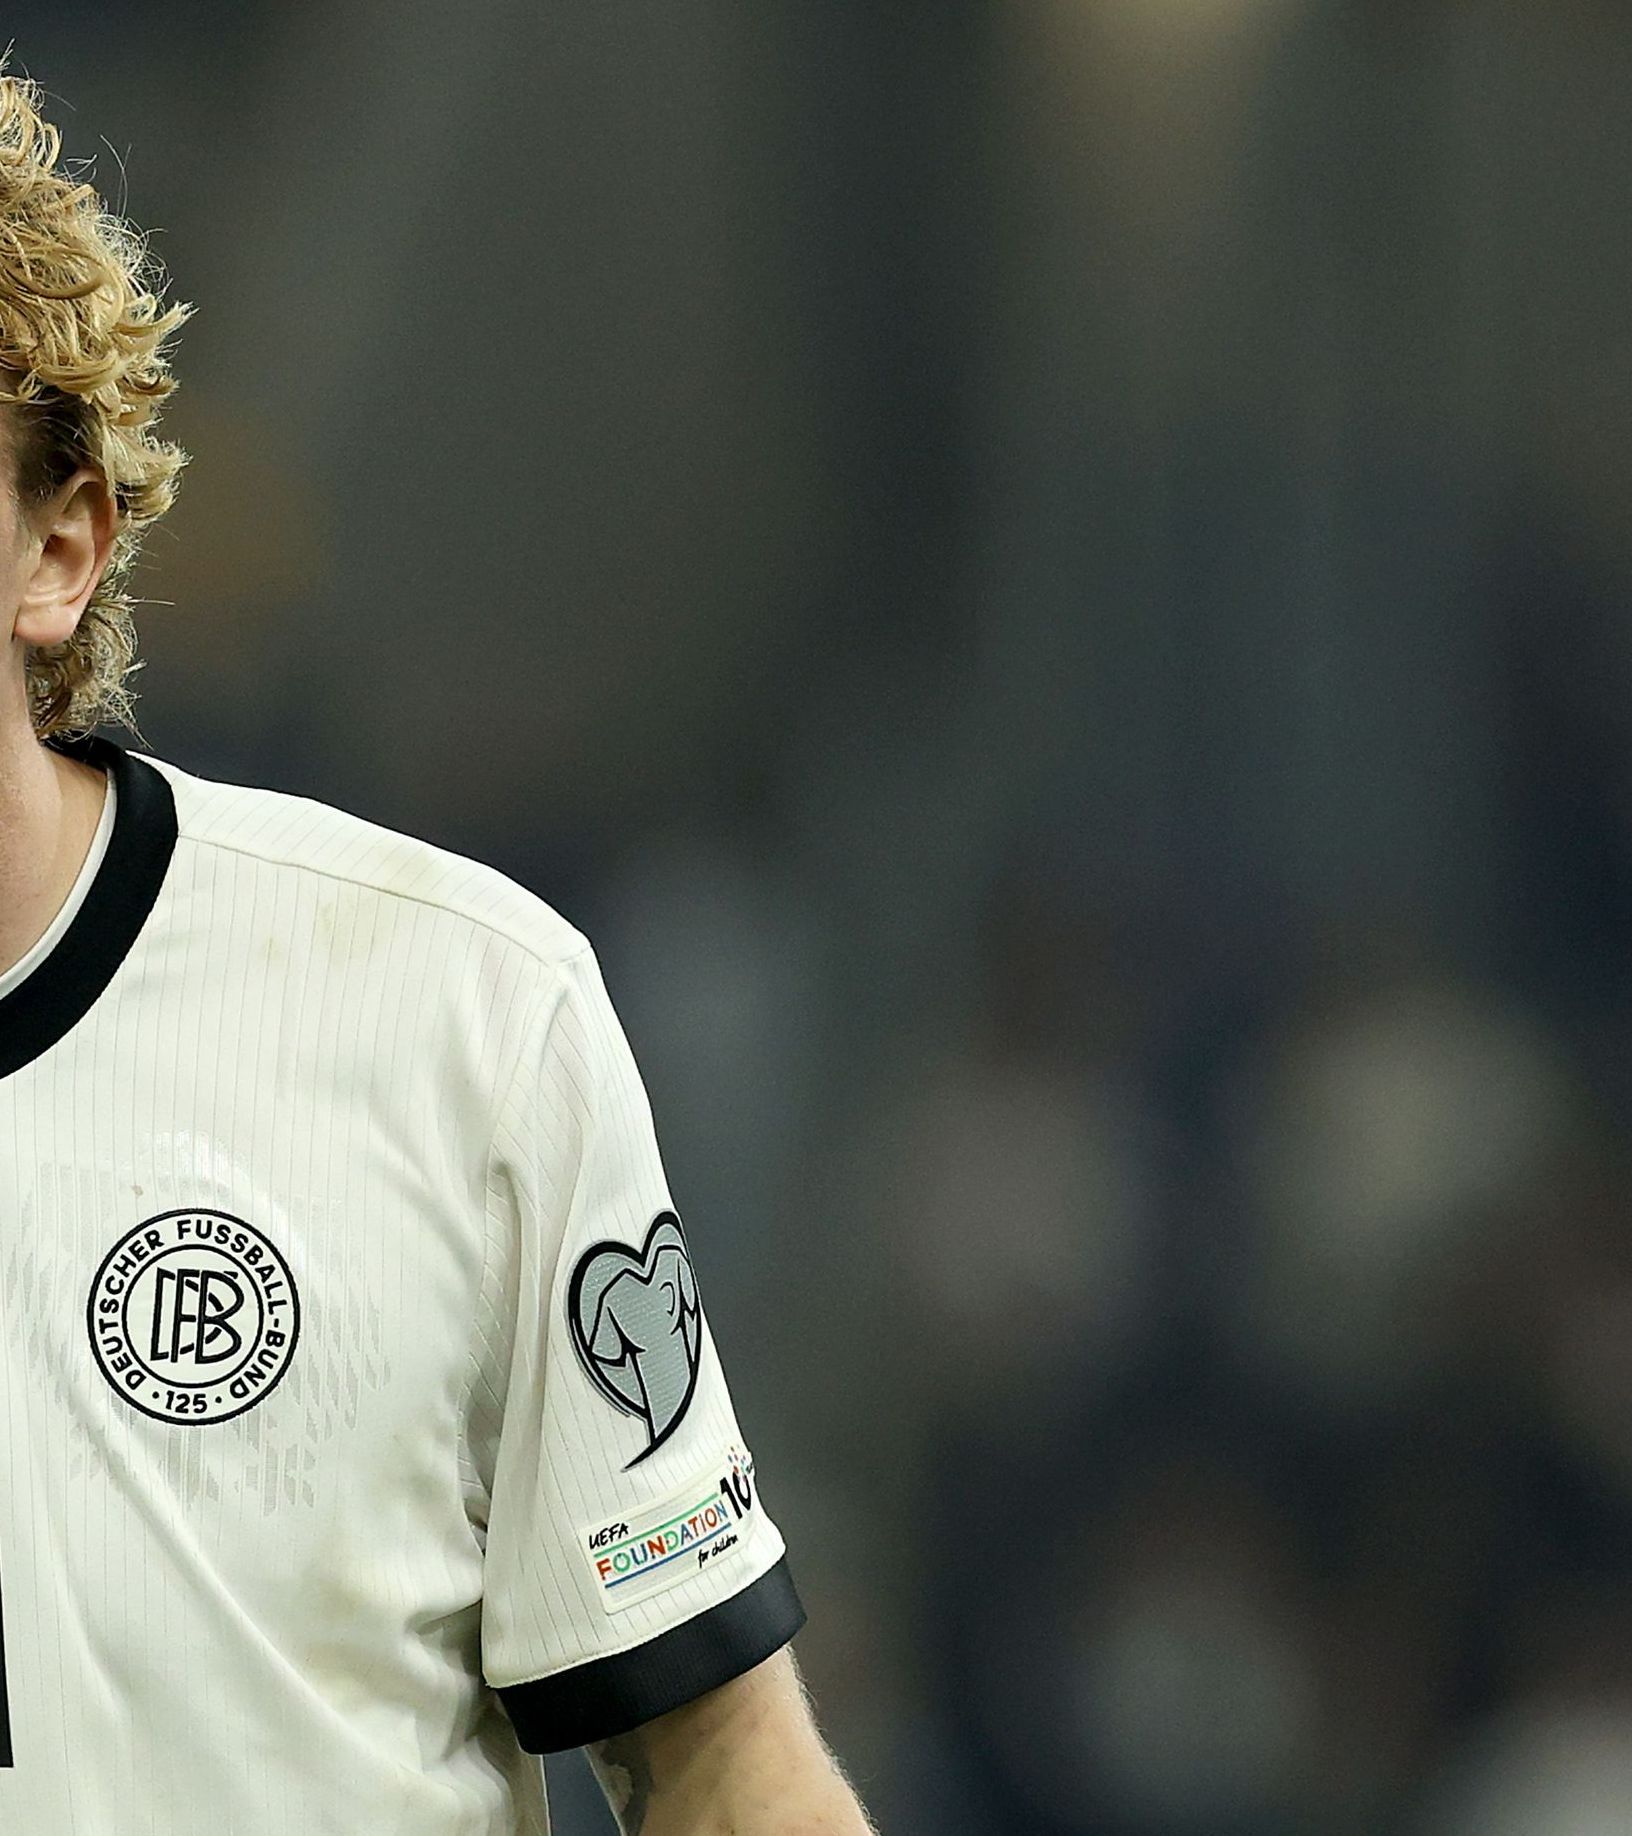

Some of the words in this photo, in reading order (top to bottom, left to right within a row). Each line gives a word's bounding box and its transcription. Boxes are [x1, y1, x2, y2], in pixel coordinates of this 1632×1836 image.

[99, 1229, 164, 1390] DEUTSCHER
[177, 1219, 287, 1399] FUSSBALL-BUND
[165, 1390, 208, 1414] 125
[589, 1522, 629, 1550] UEFA
[596, 1500, 729, 1581] FOUNDATION
[698, 1549, 710, 1569] for
